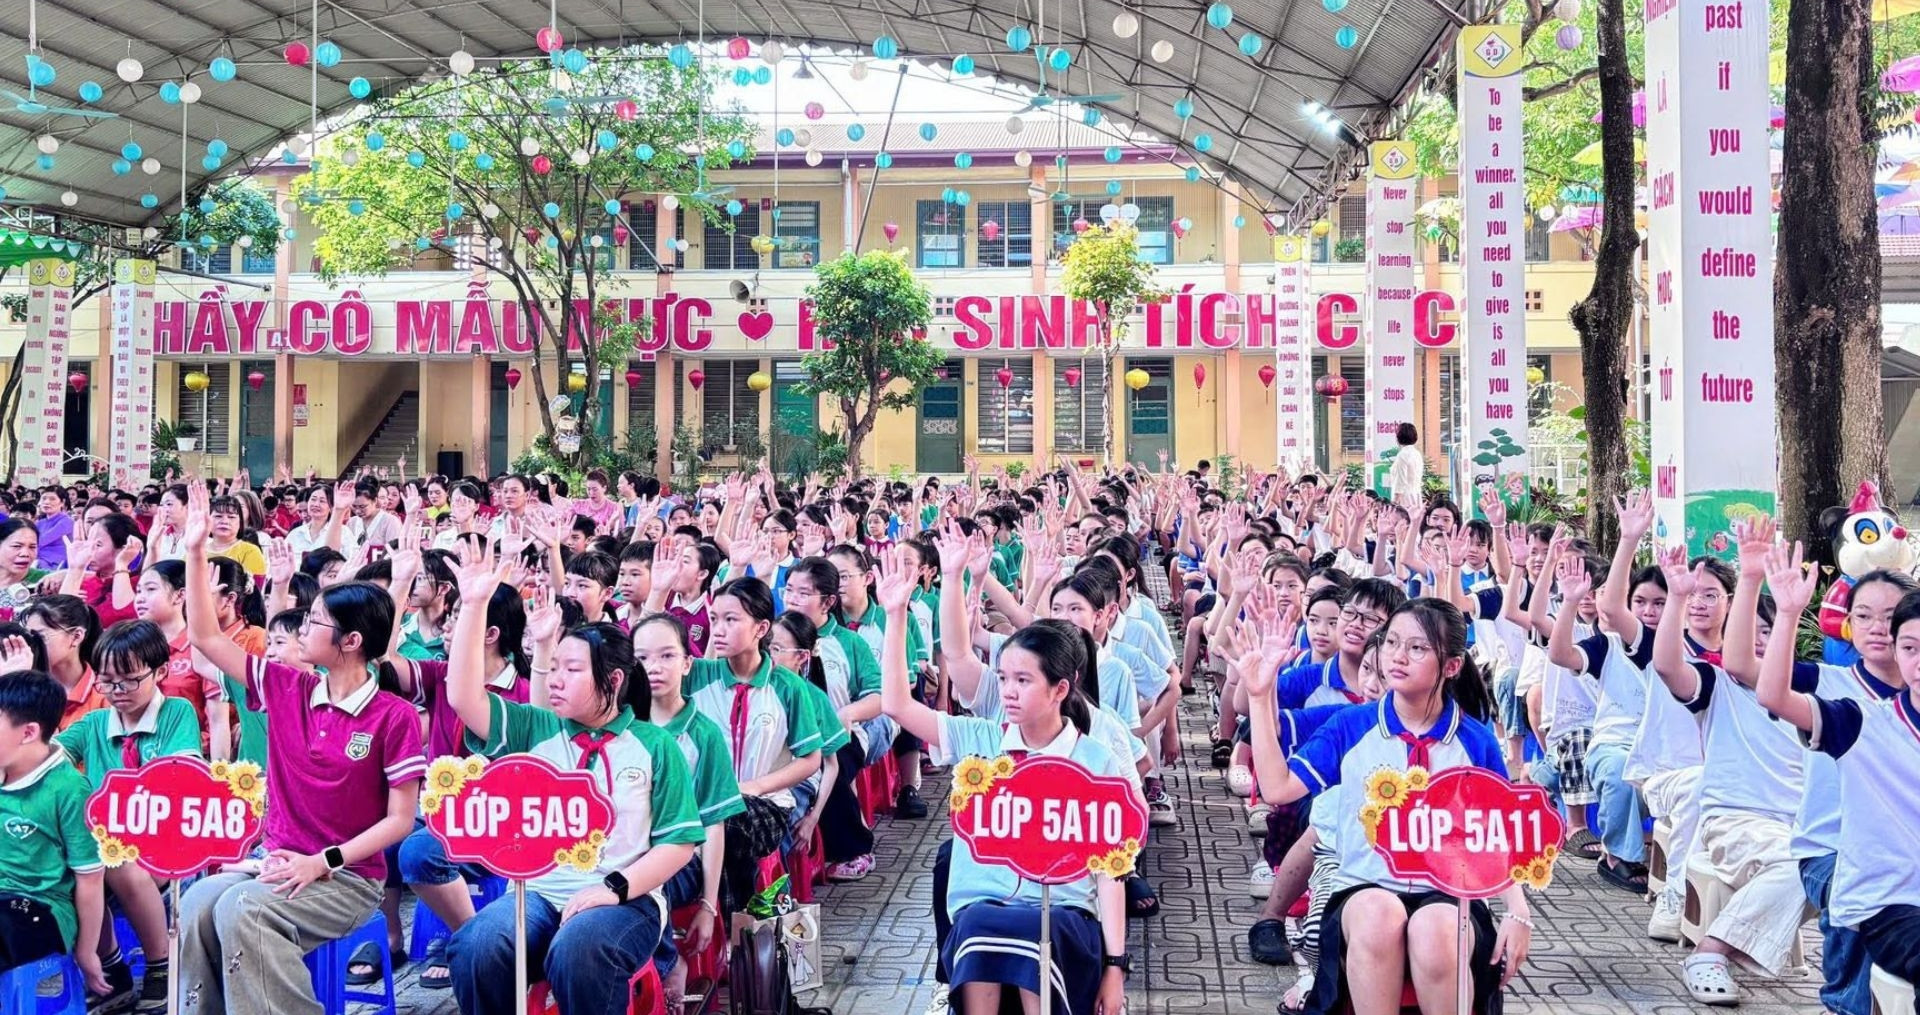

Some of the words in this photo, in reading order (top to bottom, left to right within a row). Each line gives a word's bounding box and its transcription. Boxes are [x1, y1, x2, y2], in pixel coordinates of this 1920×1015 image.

[1705, 1, 1742, 32] past
[1718, 61, 1730, 90] if
[1488, 87, 1501, 106] To
[1488, 114, 1502, 131] be
[1492, 142, 1499, 157] a
[1709, 128, 1740, 156] you
[1383, 186, 1407, 200] Never
[1653, 168, 1674, 210] CÁCH
[1489, 191, 1503, 209] all
[1698, 185, 1752, 215] would
[1386, 220, 1404, 235] stop
[1486, 220, 1507, 237] you
[1378, 253, 1411, 268] learning
[1483, 243, 1511, 261] need
[1701, 247, 1756, 278] define
[1491, 270, 1503, 287] to
[1377, 286, 1411, 300] because
[1657, 270, 1672, 312] HỌC
[1486, 295, 1509, 316] give
[154, 284, 269, 354] HẦY
[289, 289, 373, 356] CÔ
[395, 280, 542, 354] MẪU
[952, 294, 1112, 351] SINH
[1136, 283, 1277, 349] TÍCH
[1316, 290, 1456, 350] CC
[1387, 319, 1401, 333] life
[1712, 310, 1740, 339] the
[1493, 322, 1503, 340] is
[1383, 355, 1405, 367] never
[1491, 348, 1505, 366] all
[1383, 387, 1405, 402] stops
[1488, 377, 1509, 395] you
[1701, 372, 1753, 403] future
[1486, 400, 1513, 419] have
[107, 785, 171, 836] LỚP
[180, 796, 246, 840] 5A8
[445, 787, 511, 838] LỚP
[521, 796, 589, 838] 5A9
[973, 786, 1033, 839] LỚP
[1042, 798, 1123, 845] 5A10
[1388, 799, 1453, 853] LỚP
[1464, 808, 1541, 853] 5A11
